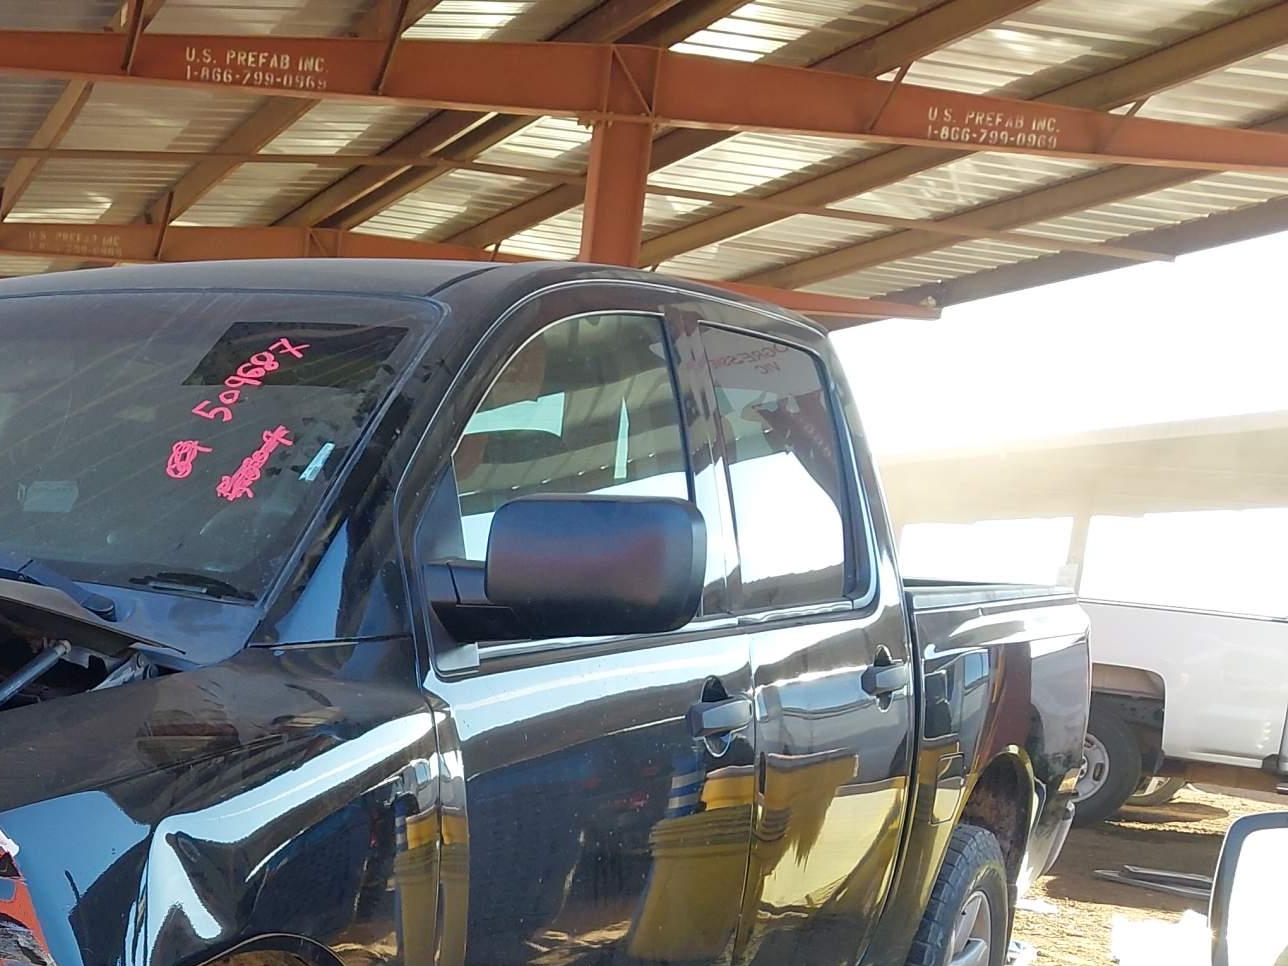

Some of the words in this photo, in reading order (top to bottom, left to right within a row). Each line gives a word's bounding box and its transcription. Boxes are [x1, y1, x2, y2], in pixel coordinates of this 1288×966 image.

[186, 47, 216, 63] U.S.
[226, 50, 290, 69] PREFAB
[965, 111, 1024, 128] PREFAB
[1032, 117, 1060, 133] INC.
